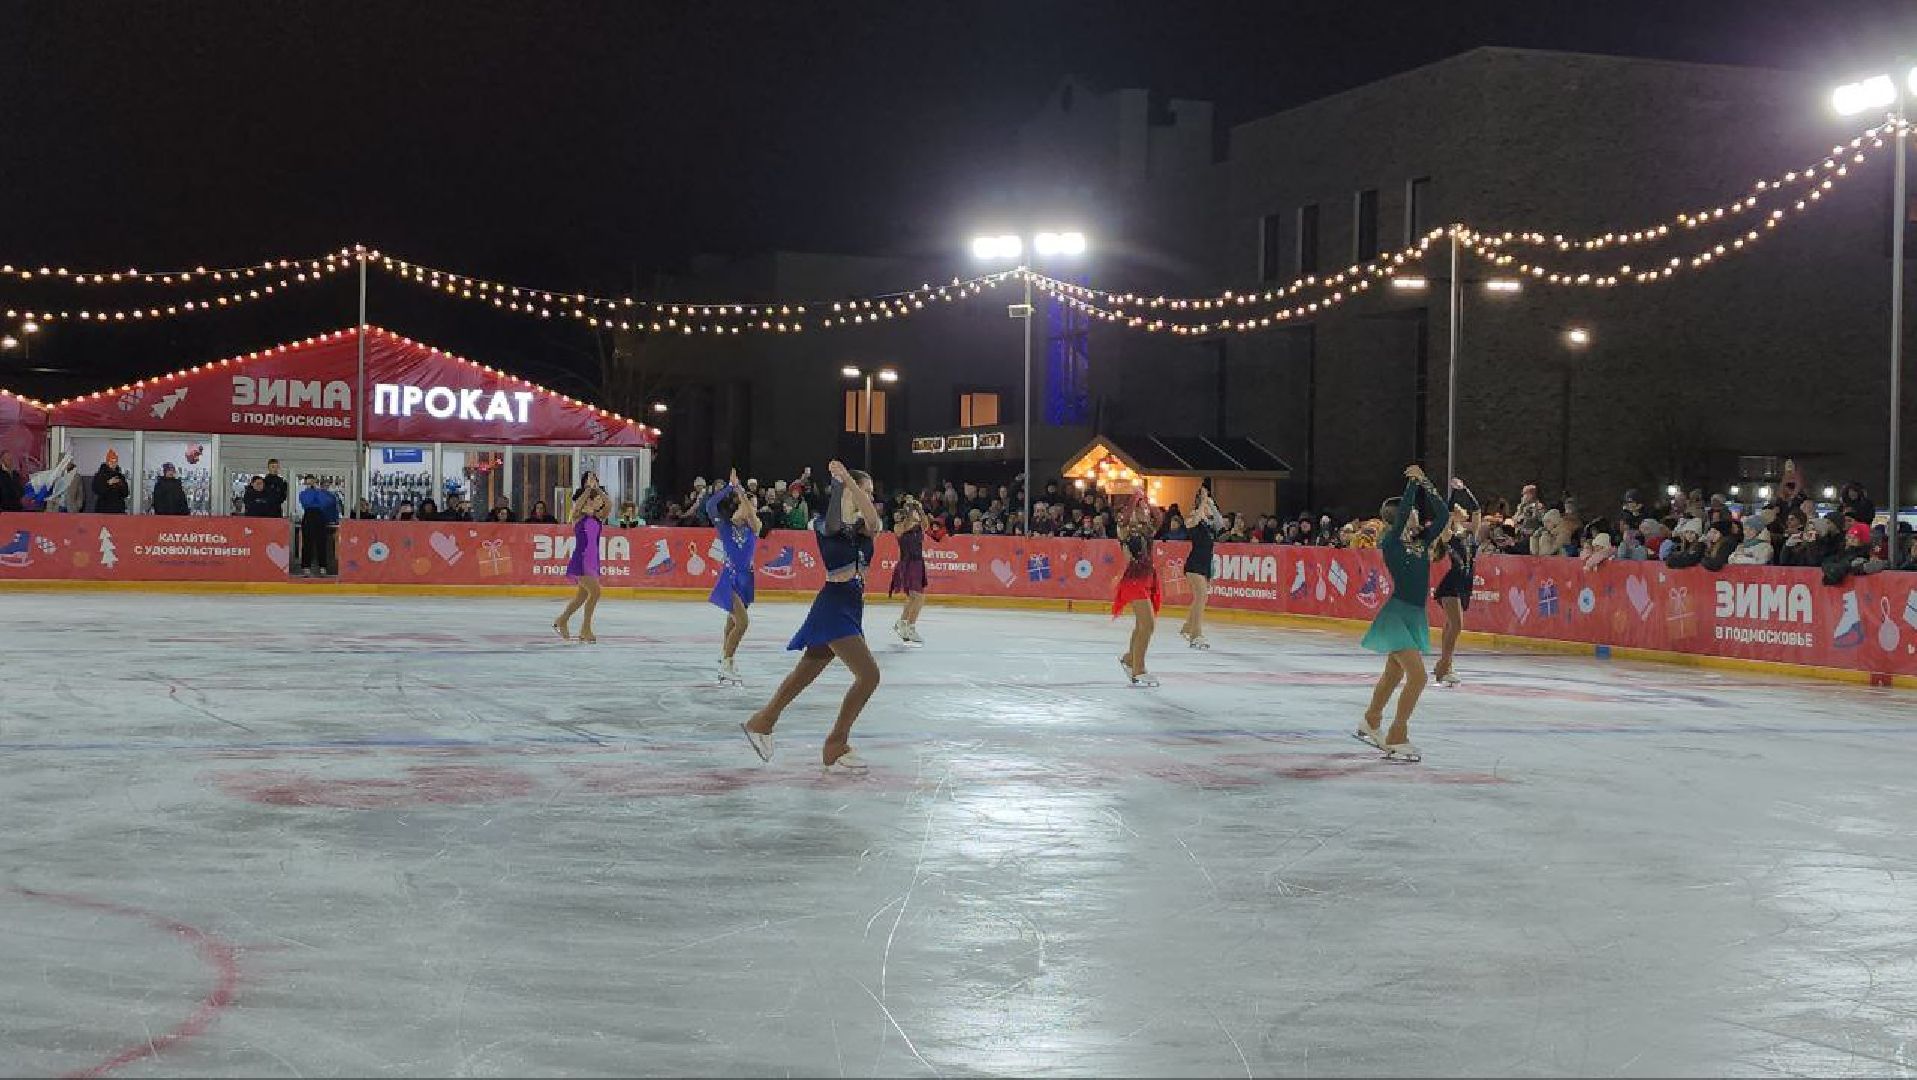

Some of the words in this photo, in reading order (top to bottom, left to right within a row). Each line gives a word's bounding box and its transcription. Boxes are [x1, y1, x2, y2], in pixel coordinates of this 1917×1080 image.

[232, 376, 351, 410] ЗИМА
[374, 383, 533, 423] ПРОКАТ
[231, 412, 240, 422] В
[244, 413, 351, 428] ПОДМОСКОВЬЕ
[159, 533, 227, 543] КАТАЙТЕСЬ
[134, 545, 142, 554] С
[533, 565, 540, 574] В
[1715, 580, 1812, 624] ЗИМА
[1715, 626, 1723, 639] В
[1725, 626, 1813, 647] ПОДМОСКОВЬЕ
